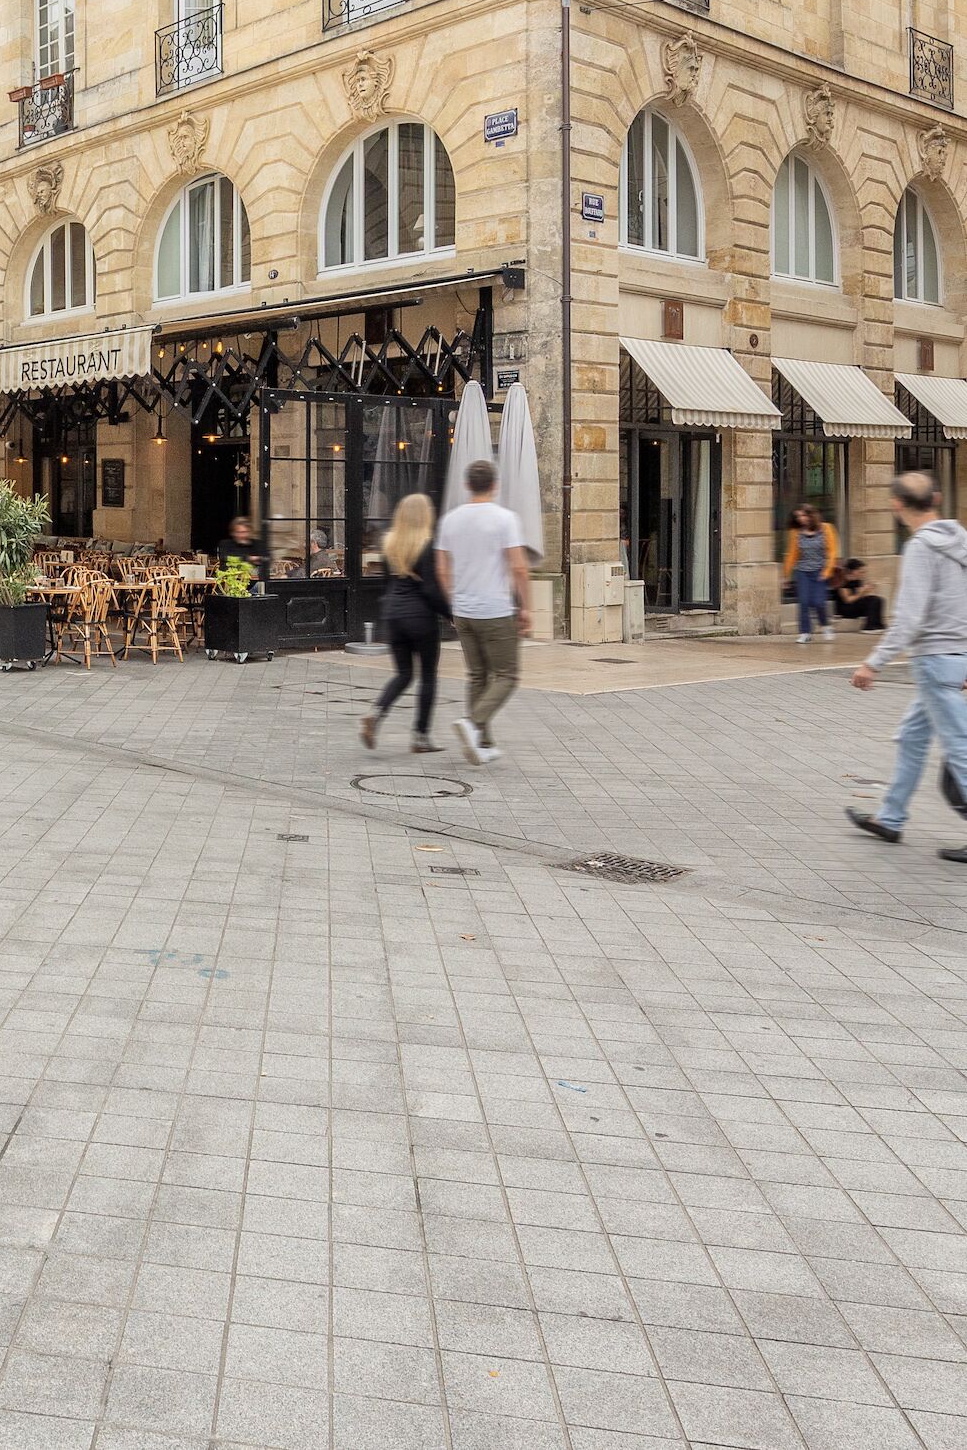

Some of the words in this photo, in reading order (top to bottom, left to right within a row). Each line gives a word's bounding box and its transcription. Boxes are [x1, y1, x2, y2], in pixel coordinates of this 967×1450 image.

[491, 115, 509, 125] PLACE
[487, 122, 515, 135] GAMBETTA
[588, 197, 599, 206] RUE
[22, 348, 122, 381] RESTAURANT
